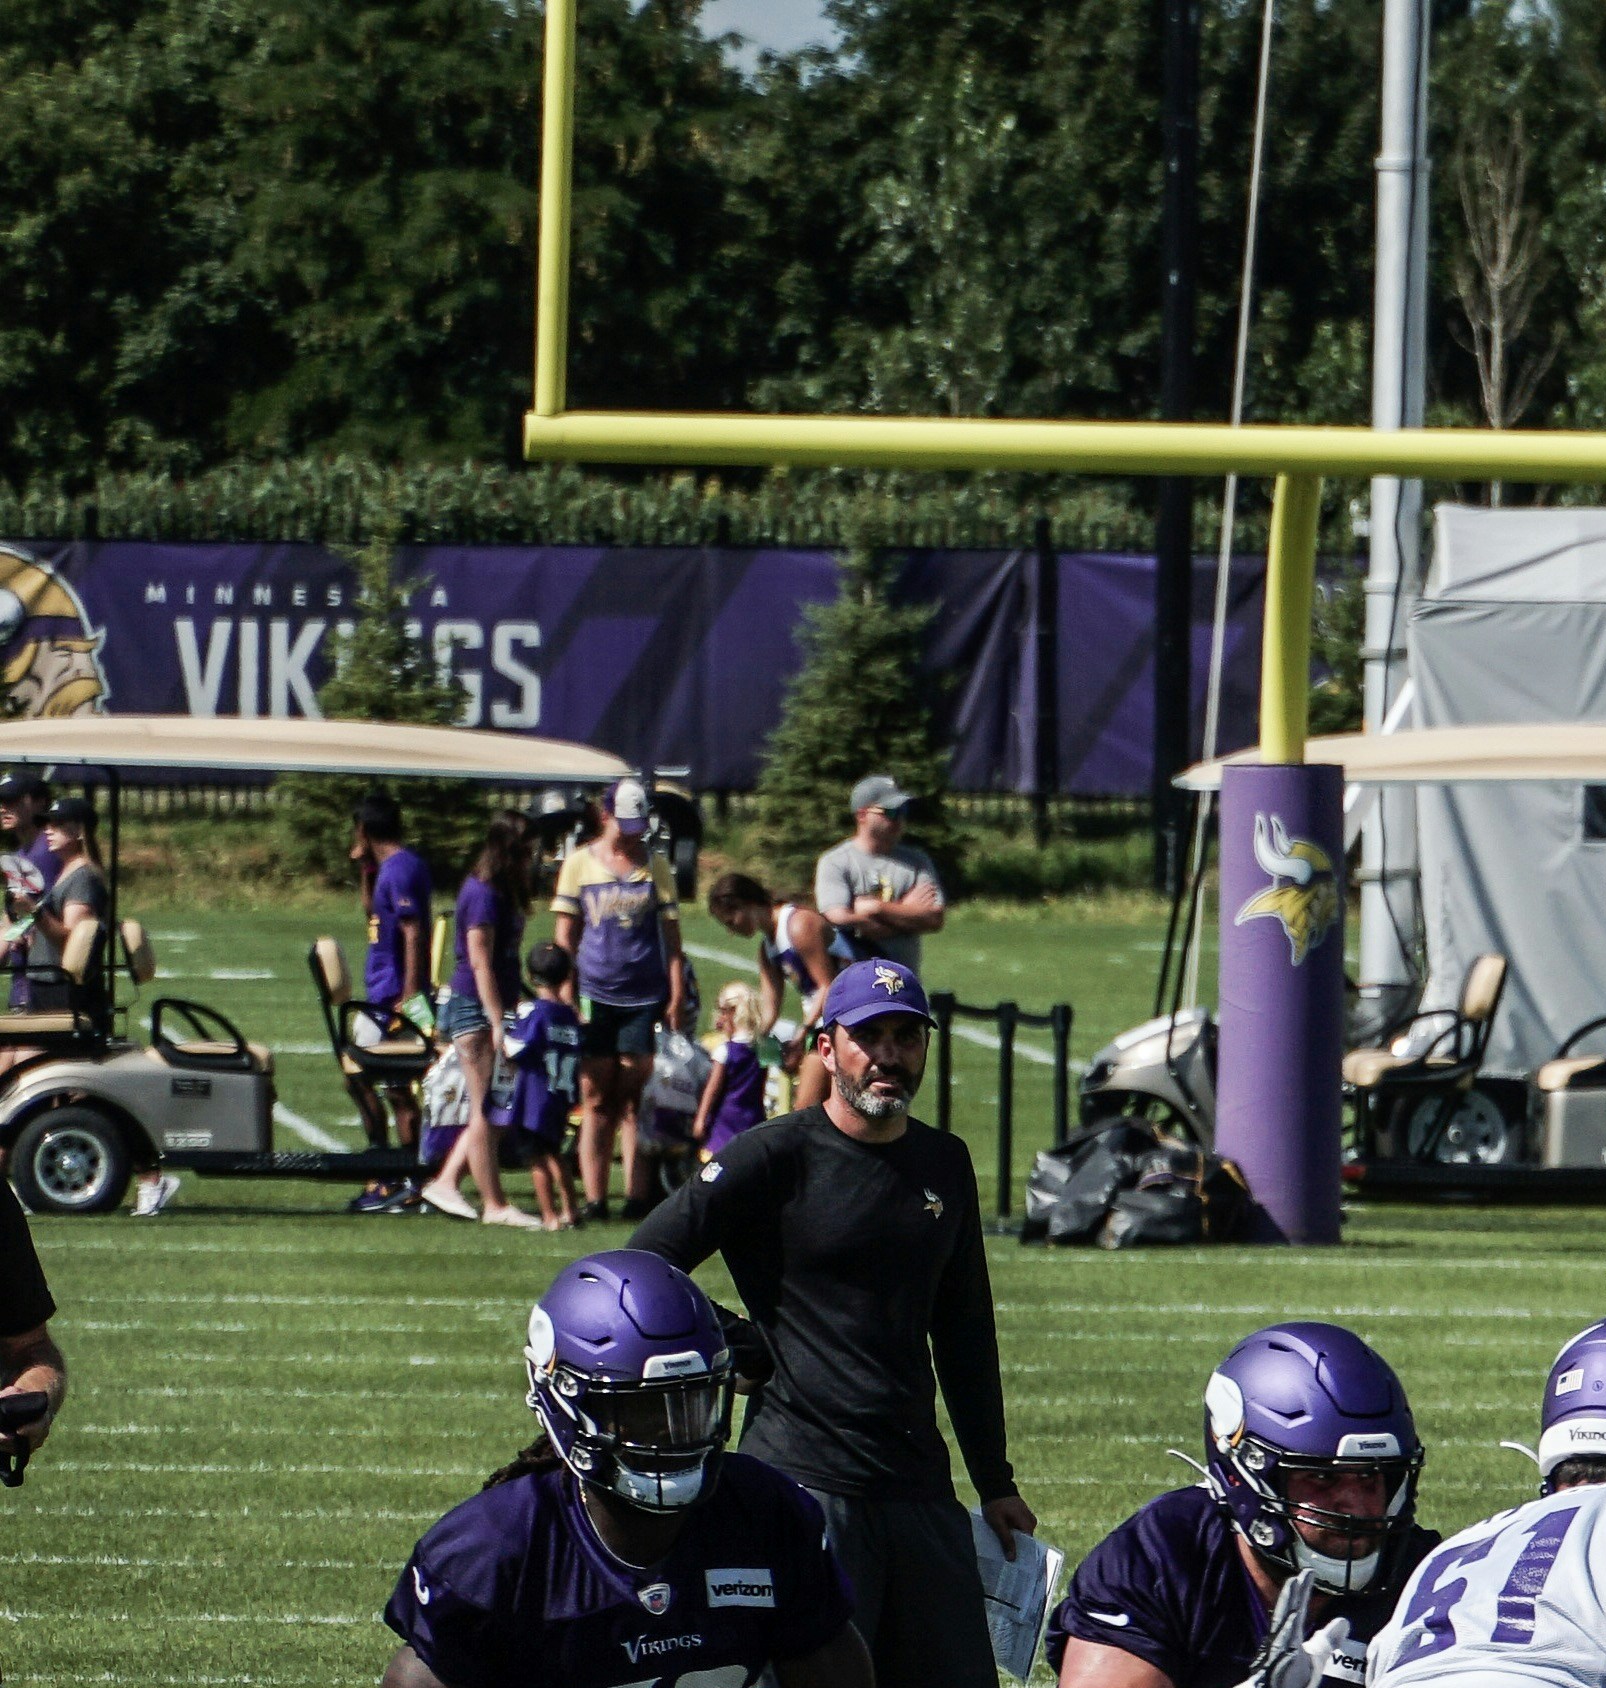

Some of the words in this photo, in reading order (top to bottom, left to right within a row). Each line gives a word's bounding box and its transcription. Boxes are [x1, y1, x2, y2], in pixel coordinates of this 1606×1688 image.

[145, 583, 448, 606] MINNESA
[174, 617, 542, 729] VIKGS
[711, 1579, 773, 1598] verizon
[1332, 1651, 1368, 1672] veri
